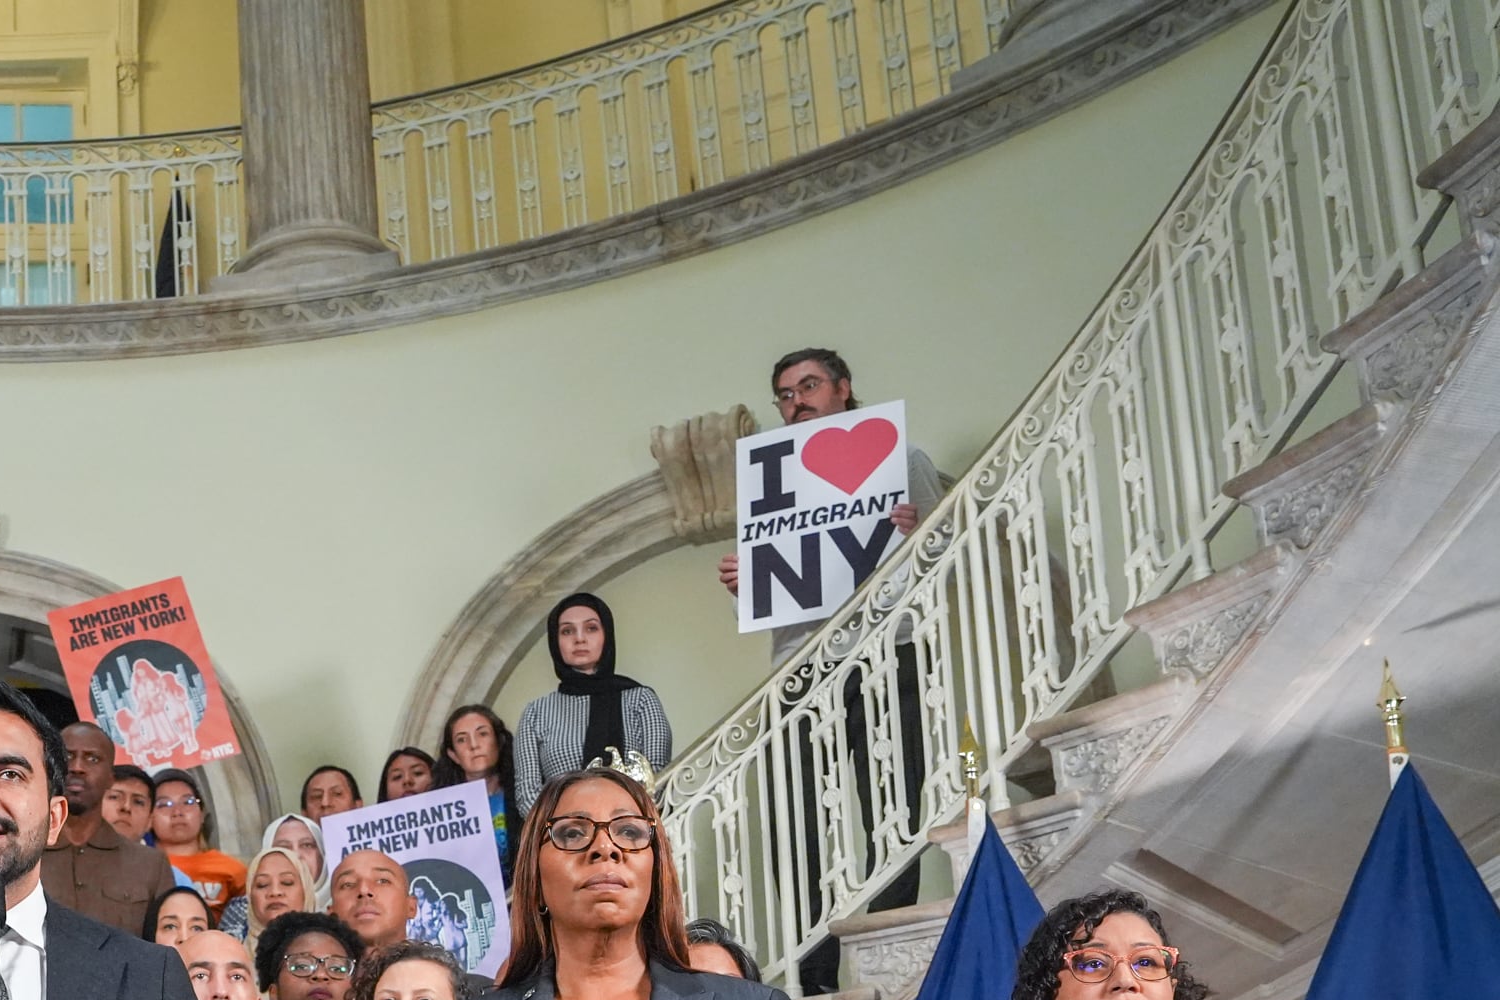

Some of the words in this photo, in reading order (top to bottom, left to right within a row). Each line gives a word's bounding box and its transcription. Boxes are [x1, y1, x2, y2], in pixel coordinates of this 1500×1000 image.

[750, 439, 796, 518] I
[741, 490, 905, 543] IMMIGRANT
[751, 517, 898, 620] NY
[68, 593, 171, 634] IMMIGRANTS
[69, 631, 99, 652] ARE
[101, 619, 136, 642] NEW
[139, 606, 187, 631] YORK!
[346, 800, 467, 843] IMMIGRANTS
[379, 830, 419, 853] NEW
[424, 816, 481, 845] YORK!
